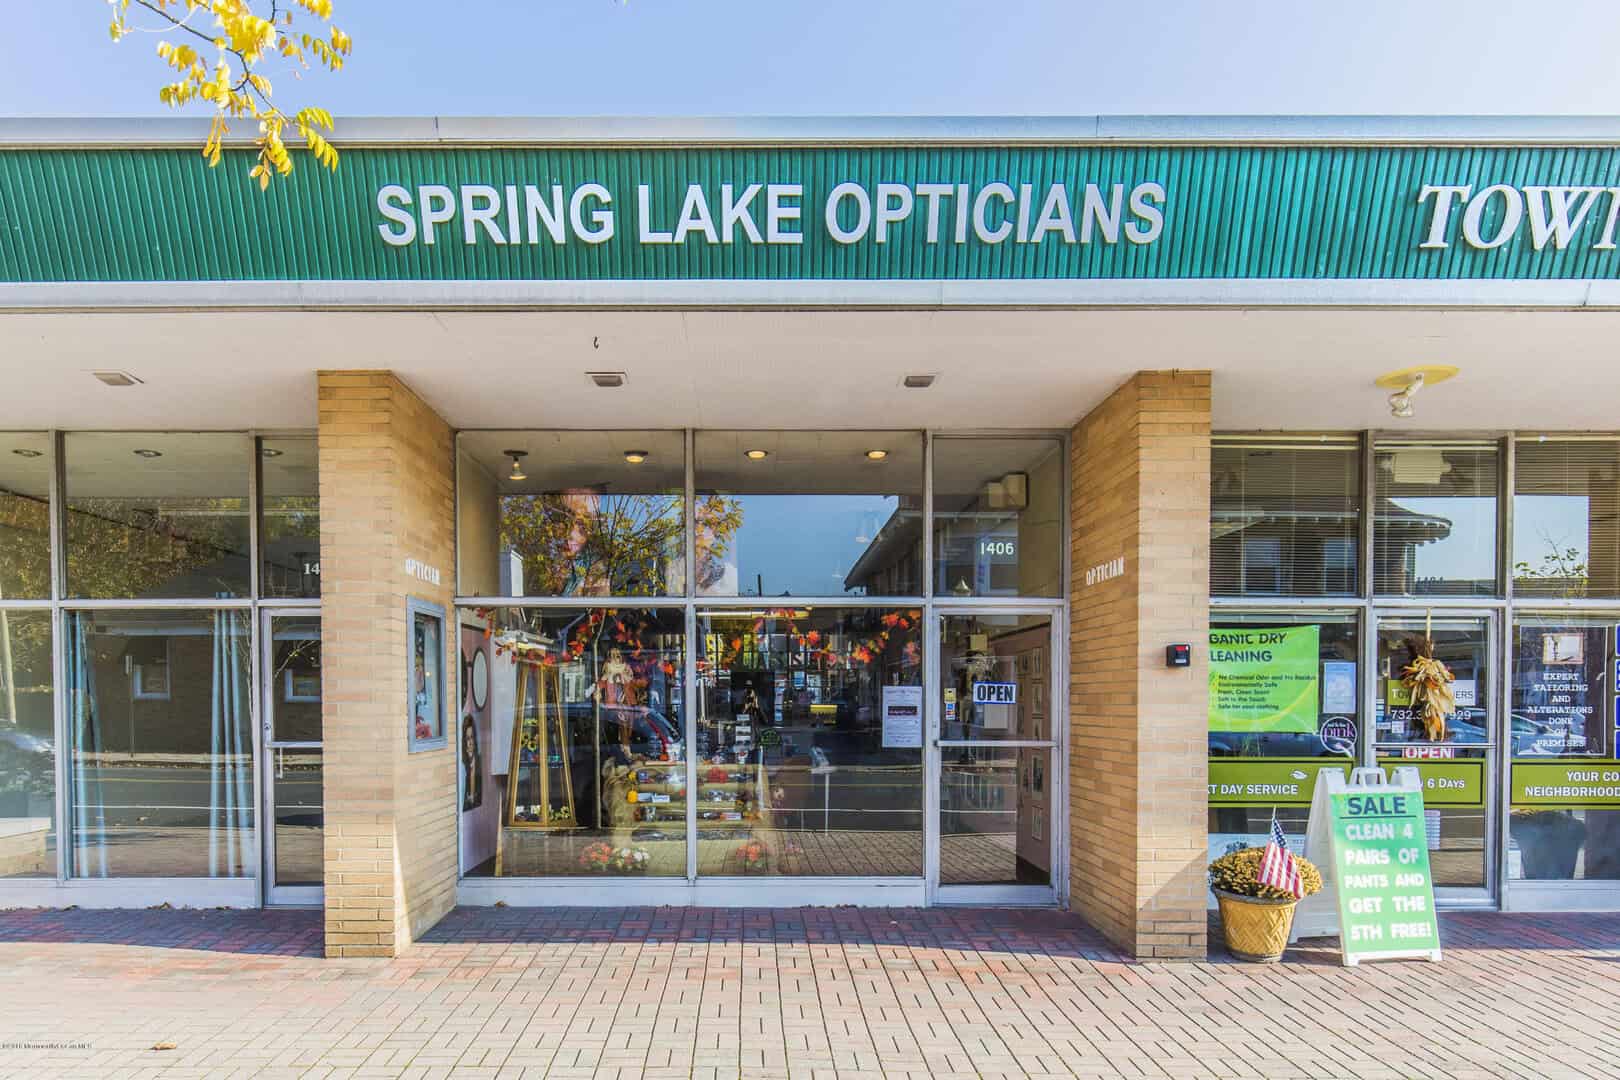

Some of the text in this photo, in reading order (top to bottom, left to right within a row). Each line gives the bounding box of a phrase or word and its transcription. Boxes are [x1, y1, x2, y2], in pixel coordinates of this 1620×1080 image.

[376, 182, 1167, 246] SPRING LAKE OPTICIANS
[980, 542, 1015, 556] 1406
[405, 558, 441, 586] OPTICIAN
[1086, 556, 1125, 586] OPTICIAN
[1259, 632, 1287, 644] DRY
[1543, 673, 1579, 681] EXPERT
[977, 685, 1014, 701] OPEN
[1534, 684, 1588, 692] TAILORING
[1552, 695, 1571, 703] AND
[1527, 706, 1593, 714] ALTERATIONS
[1548, 717, 1574, 725] DONE
[1324, 723, 1354, 742] pink
[1406, 746, 1452, 758] OPEN
[1427, 778, 1435, 788] 6
[1567, 771, 1599, 782] YOUR
[1221, 784, 1244, 794] DAY
[1247, 784, 1298, 795] SERVICE
[1348, 796, 1407, 815] SALE
[1345, 823, 1395, 840] CLEAN
[1403, 823, 1414, 839] 4
[1344, 847, 1419, 865] PAIRS OF
[1344, 873, 1424, 888] PANTS AND
[1349, 896, 1426, 913] GET THE
[1350, 922, 1432, 940] 5TH FREE!
